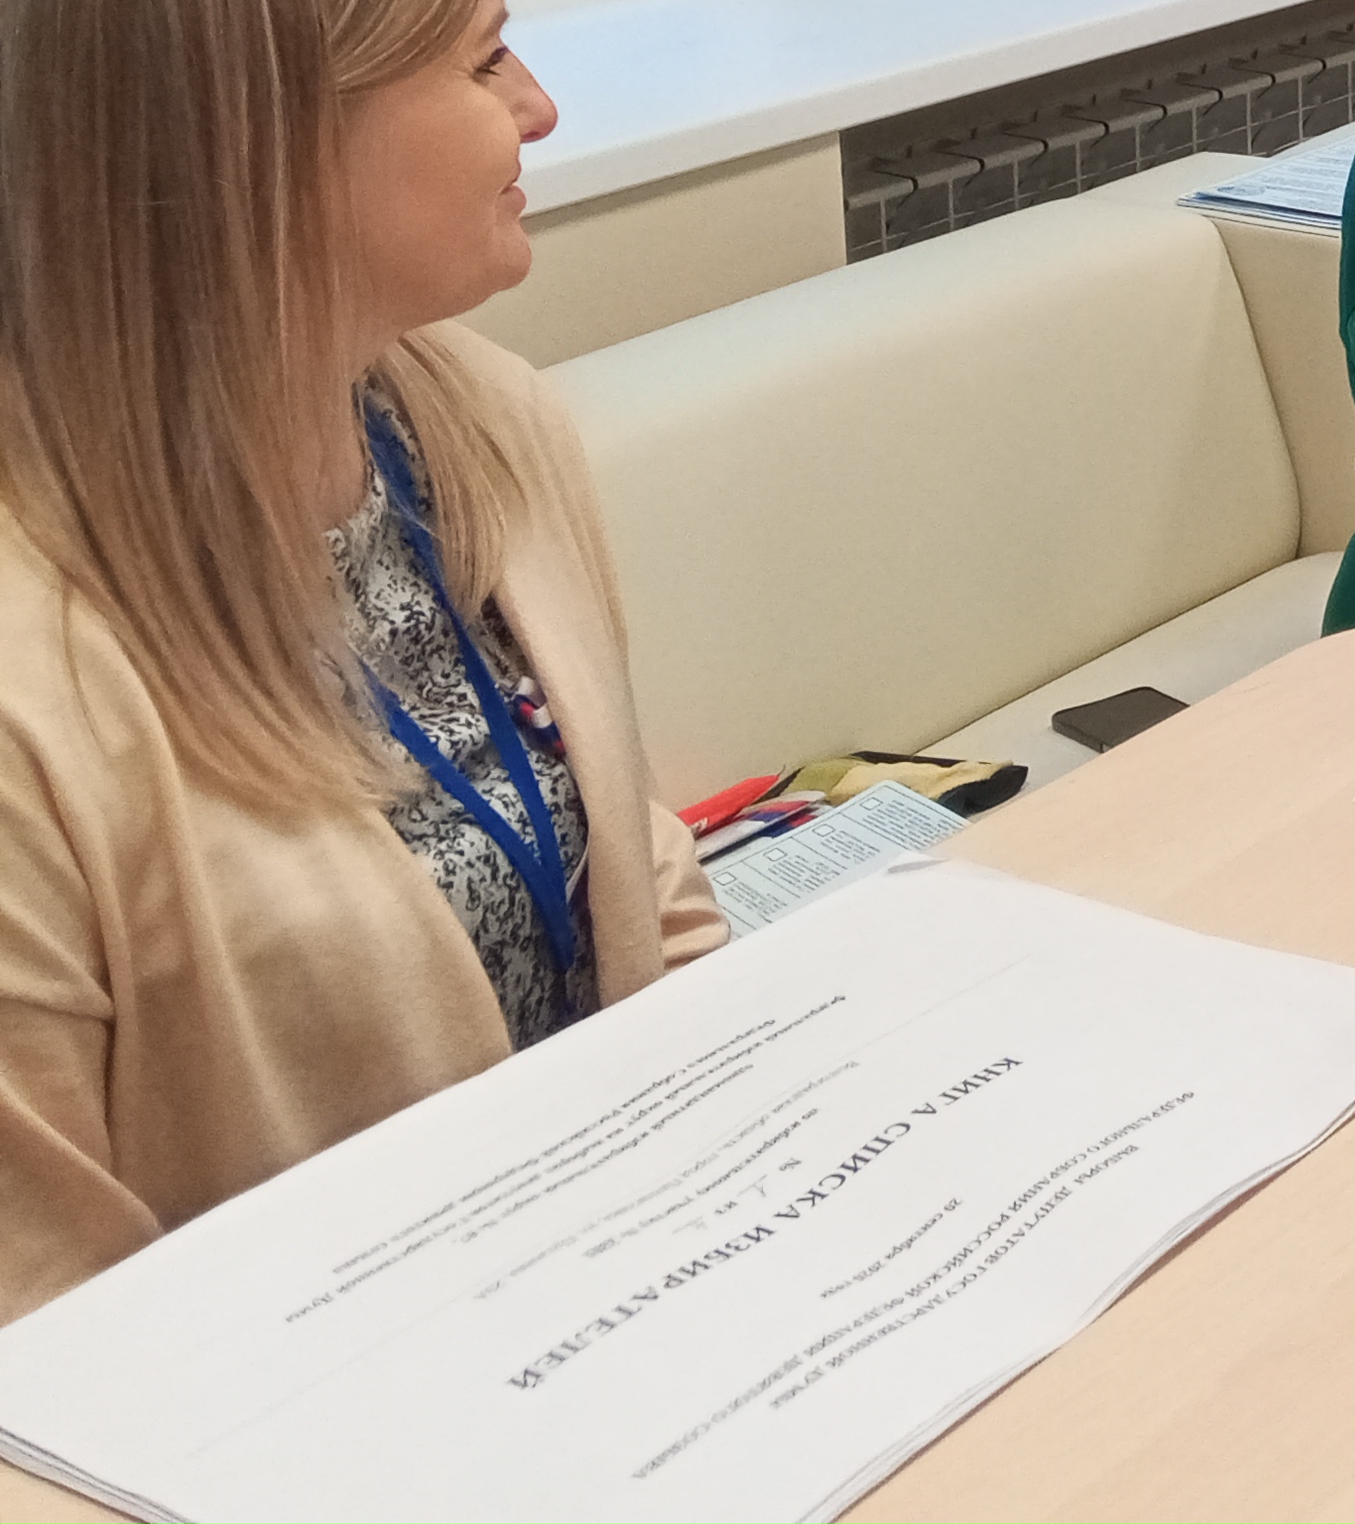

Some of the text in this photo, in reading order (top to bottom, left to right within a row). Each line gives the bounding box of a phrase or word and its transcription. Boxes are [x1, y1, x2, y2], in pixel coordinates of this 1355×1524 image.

[1087, 1092, 1194, 1153] ФЕДЕРАЛЬНОГО
[1007, 1153, 1087, 1213] СОБРАНИЯ
[1073, 1144, 1140, 1185] ВЫБОРЫ
[505, 1057, 1024, 1390] КНИГА СПИСКА ИЗБИРАТЕЛЕЙ
[943, 1197, 963, 1212] 20
[984, 1186, 1073, 1265] ДЕПУТАТОВ
[884, 1212, 943, 1260] сентября
[905, 1212, 1012, 1298] РОССИЙСКОЙ
[825, 1265, 988, 1369] ГОСУДАРСТВЕННОЙ
